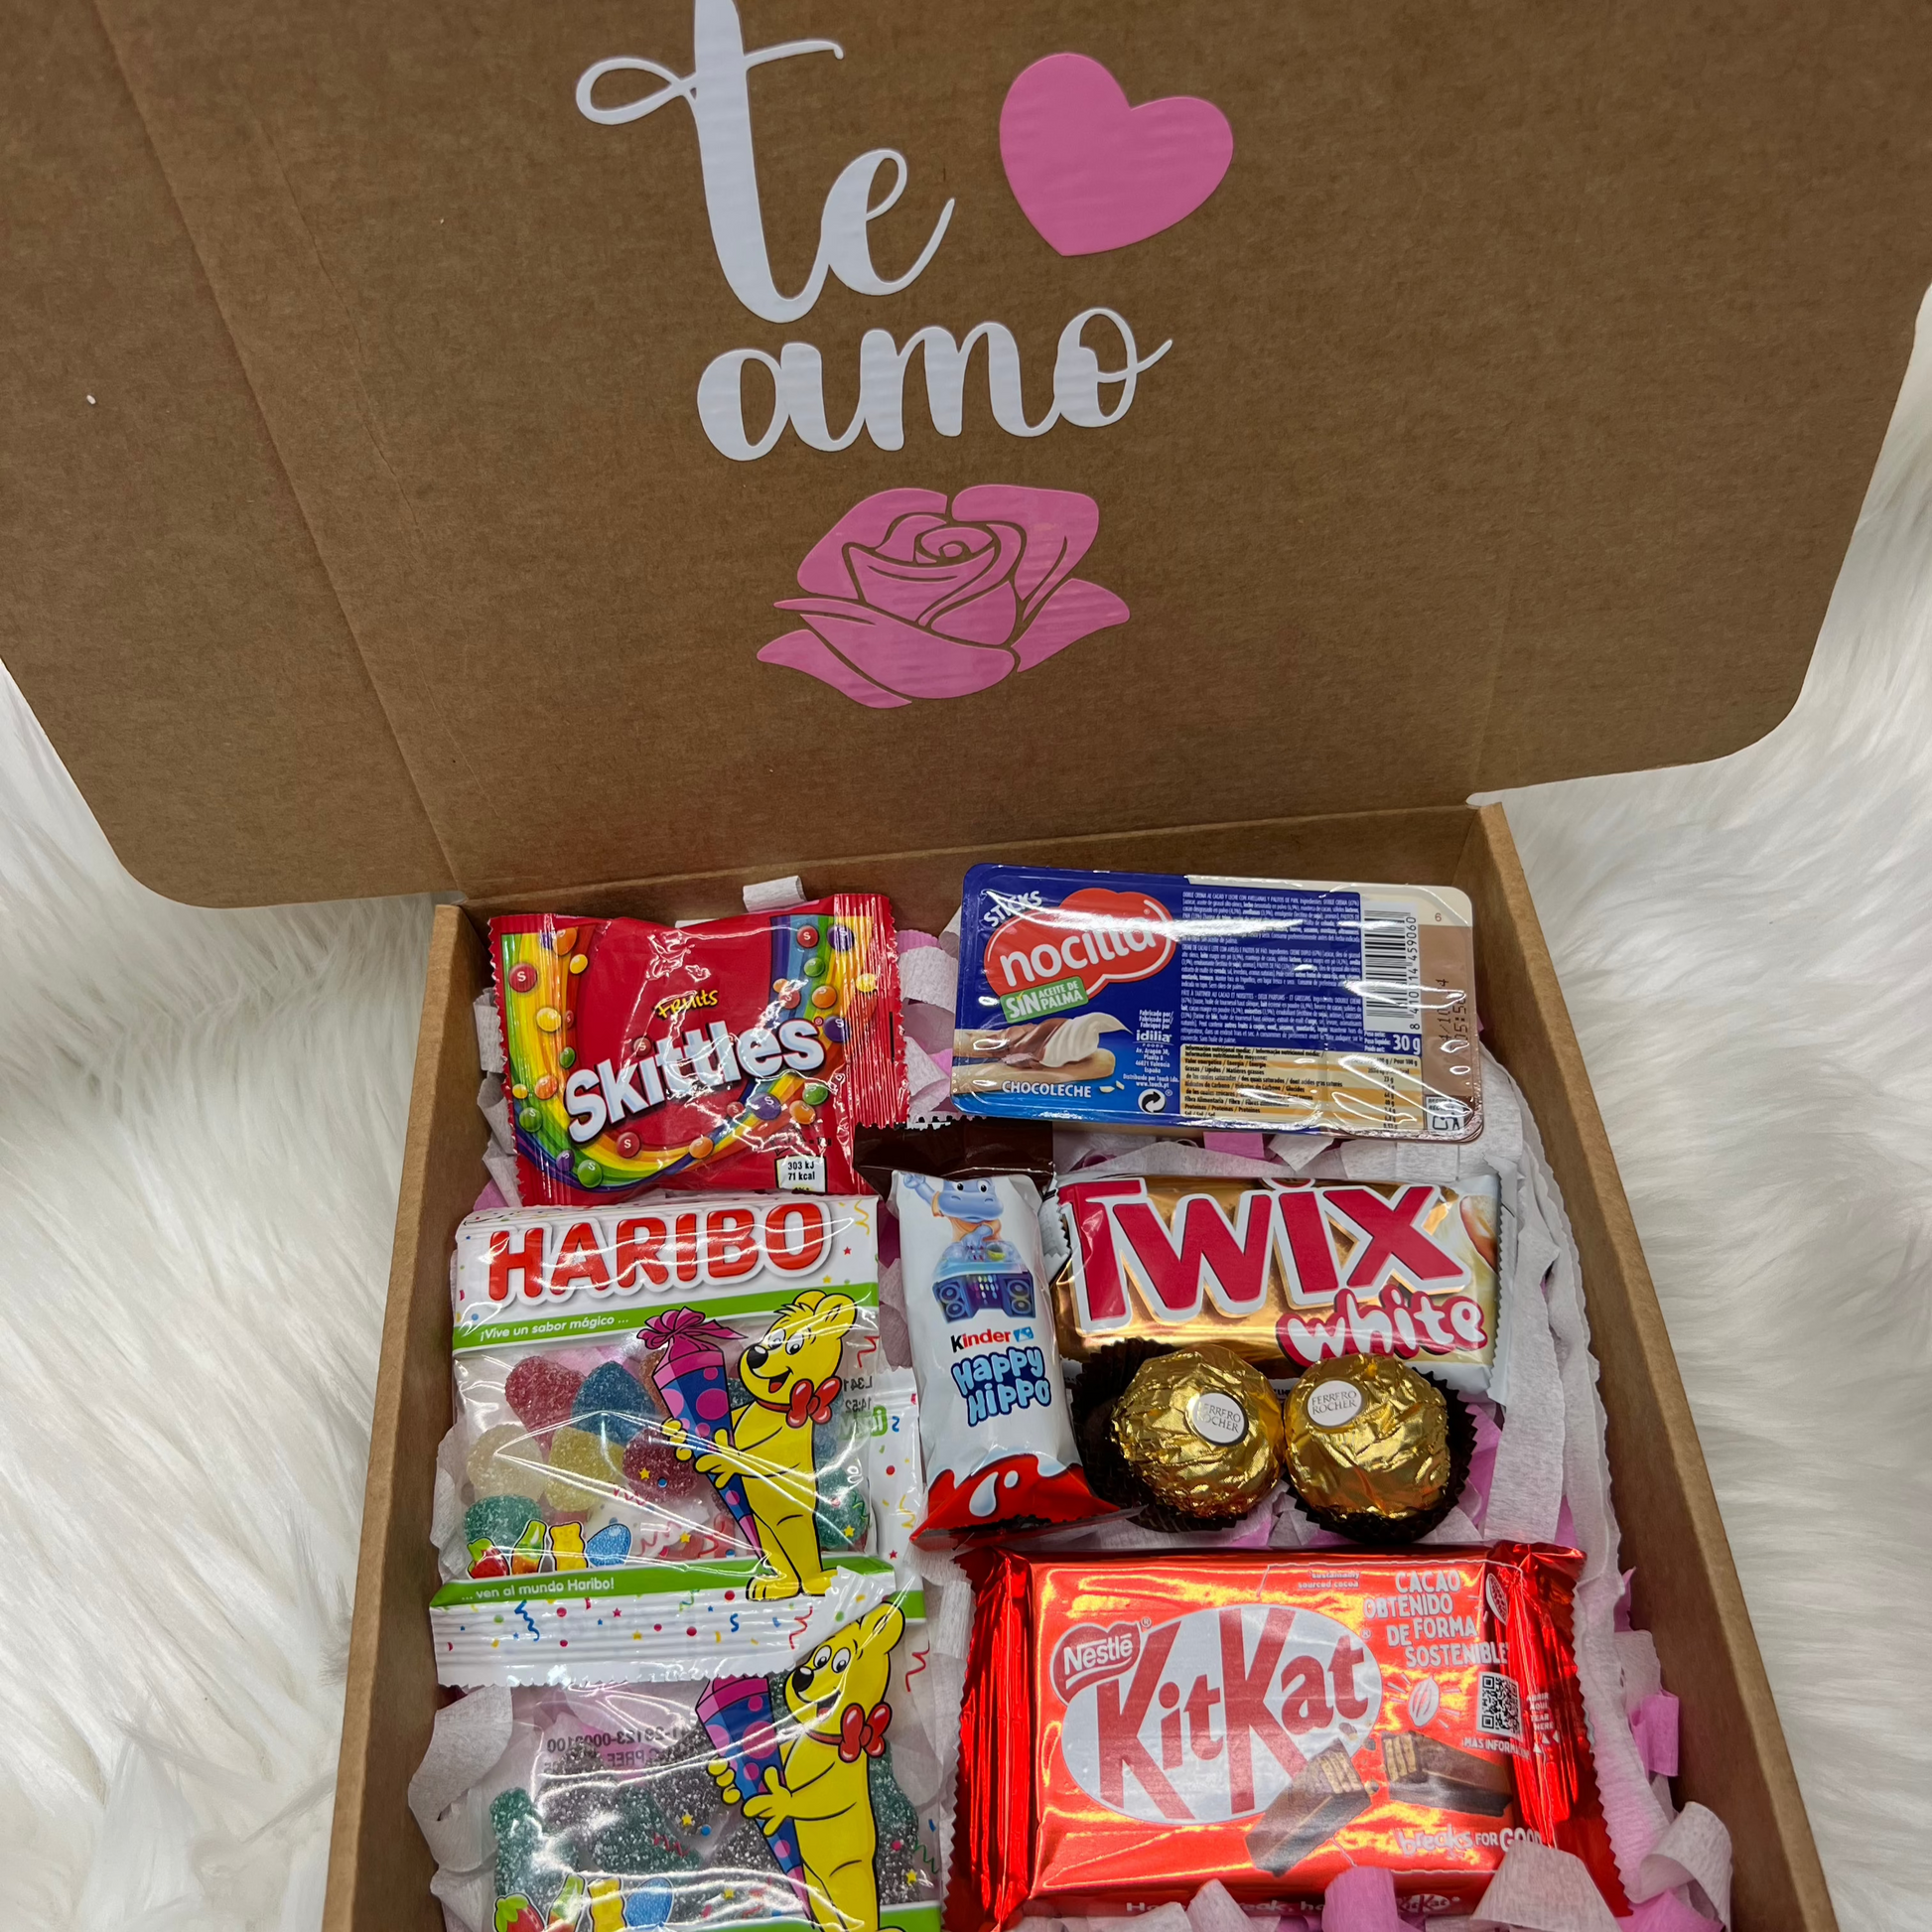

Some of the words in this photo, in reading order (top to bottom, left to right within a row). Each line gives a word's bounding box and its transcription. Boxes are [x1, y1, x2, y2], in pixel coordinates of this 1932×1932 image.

[576, 0, 954, 324] te
[697, 308, 1173, 461] amo
[983, 891, 1042, 927] STICKS
[1000, 913, 1157, 987] nocilla
[1038, 986, 1067, 1000] ACEITE
[1067, 980, 1079, 990] DE
[1040, 992, 1083, 1011] PALMA
[1136, 1030, 1171, 1042] idilia
[1393, 1035, 1408, 1051] 30
[1412, 1037, 1421, 1055] g
[563, 1019, 825, 1143] Skittles
[1002, 1081, 1091, 1098] CHOCOLECHE
[787, 1161, 802, 1170] 303
[805, 1161, 814, 1170] kJ
[798, 1172, 815, 1180] kcal
[488, 1202, 823, 1302] HARIBO
[480, 1327, 509, 1341] ¡Vive
[513, 1326, 528, 1336] un
[531, 1321, 567, 1334] sabor
[569, 1315, 615, 1330] mágico
[1283, 1290, 1486, 1364] white
[950, 1328, 1012, 1353] Kinder
[951, 1347, 1044, 1397] Happy
[967, 1378, 1050, 1426] Hippo
[1311, 1390, 1357, 1406] FERRERO
[1311, 1399, 1357, 1415] ROCHER
[476, 1588, 499, 1599] ven
[502, 1585, 515, 1595] al
[518, 1580, 565, 1595] mundo
[568, 1577, 615, 1592] Haribo!
[1396, 1570, 1461, 1593] CACAO
[1364, 1593, 1453, 1619] OBTENIDO
[1387, 1624, 1412, 1647] DE
[1413, 1615, 1478, 1639] FORMA
[1096, 1607, 1369, 1820] KitKat
[1398, 1824, 1474, 1857] breaks
[1475, 1832, 1499, 1847] FOR
